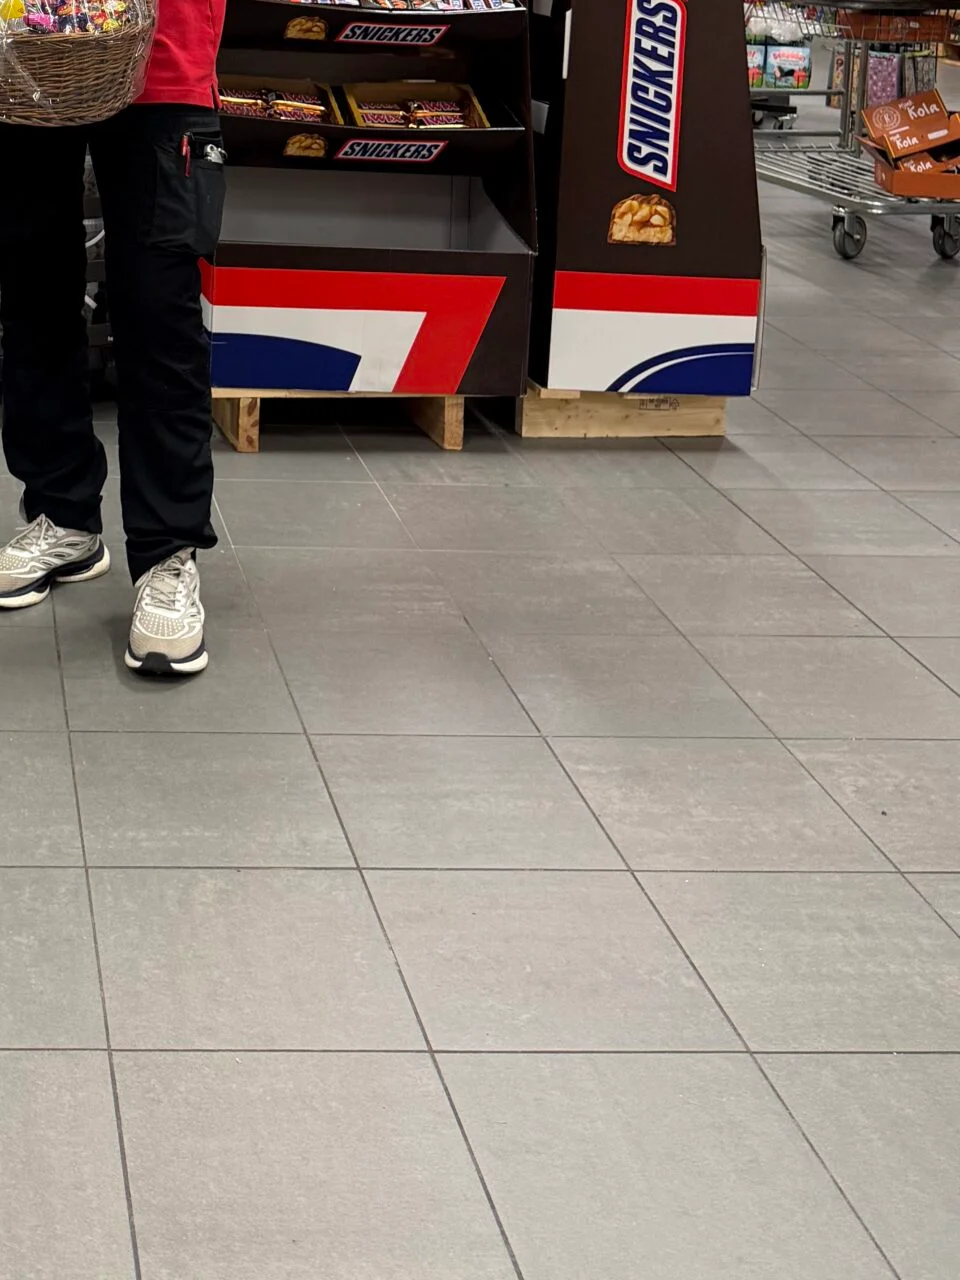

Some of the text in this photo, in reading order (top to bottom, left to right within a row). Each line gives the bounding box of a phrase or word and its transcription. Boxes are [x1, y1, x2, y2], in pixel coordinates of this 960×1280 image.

[342, 24, 442, 44] SNICKERS
[907, 102, 940, 120] Kola
[342, 140, 439, 160] SNICKERS
[895, 136, 919, 150] Kola
[909, 161, 933, 173] Kola
